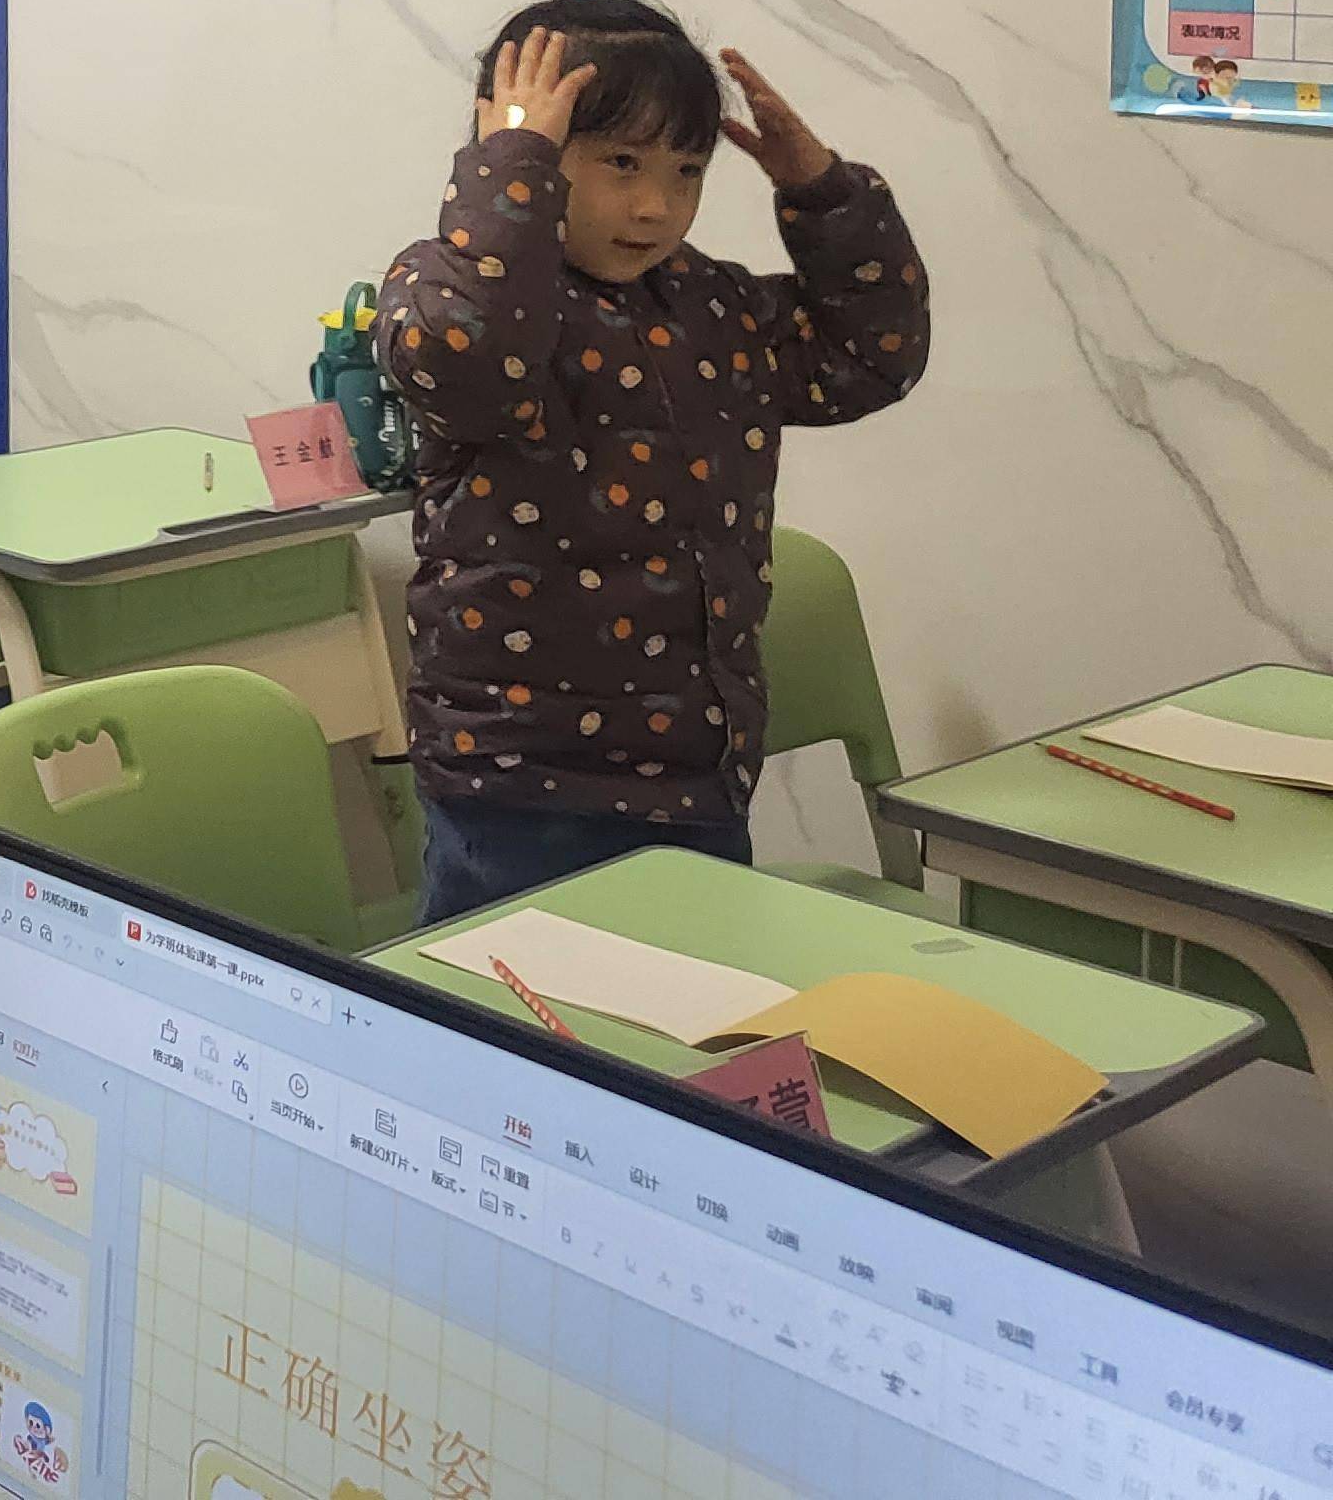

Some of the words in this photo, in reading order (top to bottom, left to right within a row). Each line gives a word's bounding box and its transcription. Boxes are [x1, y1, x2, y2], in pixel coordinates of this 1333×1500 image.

[1181, 24, 1241, 40] 表现情况
[153, 1048, 183, 1073] 格式刷
[270, 1099, 315, 1131] 当页开始
[504, 1114, 532, 1140] 开始
[350, 1133, 410, 1173] 新建幻灯片
[565, 1139, 594, 1167] 插入
[432, 1170, 457, 1193] 版式
[503, 1165, 530, 1189] 重置
[629, 1166, 660, 1192] 设计
[502, 1200, 515, 1217] 节
[696, 1193, 729, 1222] 切换
[765, 1223, 800, 1252] 动画
[214, 1313, 491, 1500] 正确坐姿
